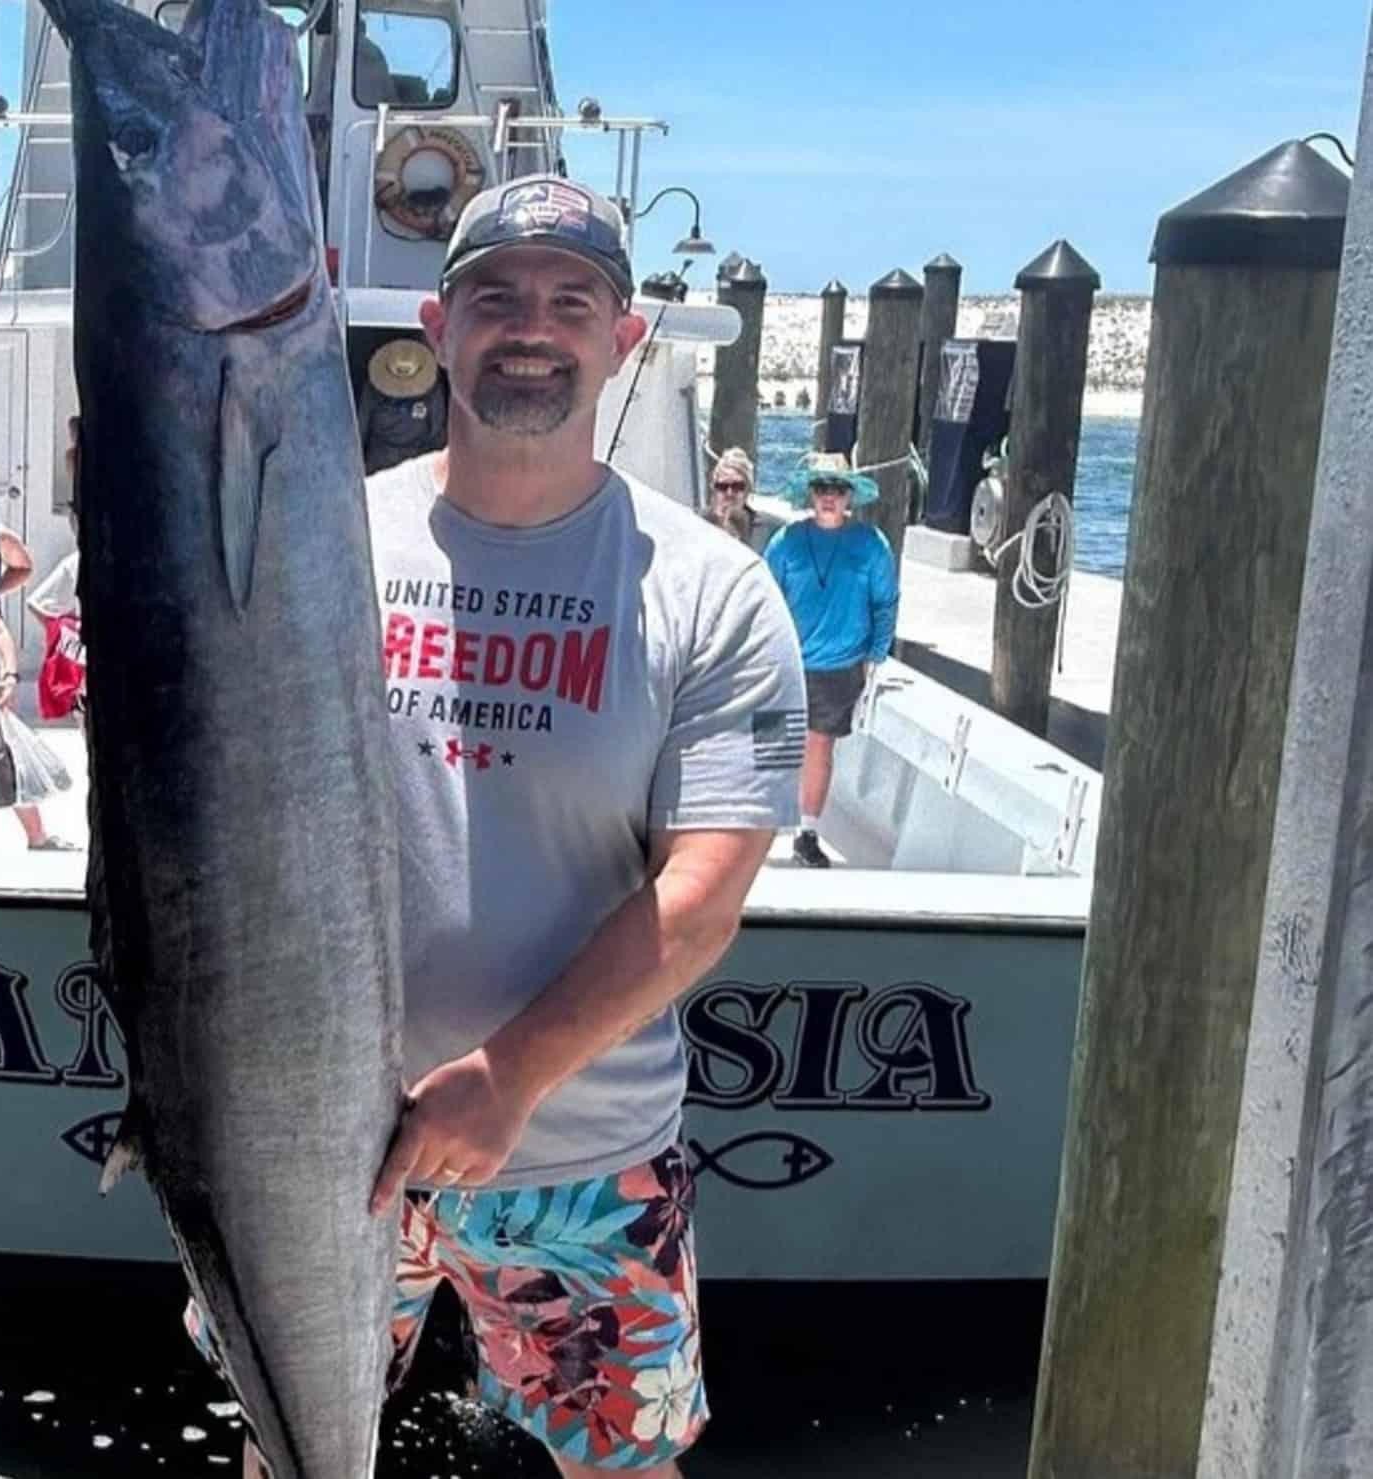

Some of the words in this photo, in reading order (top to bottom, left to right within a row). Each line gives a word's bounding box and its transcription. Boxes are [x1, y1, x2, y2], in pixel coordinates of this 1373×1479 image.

[384, 579, 485, 615] UNITED
[494, 588, 596, 625] STATES
[383, 611, 610, 714] REEDOM
[388, 687, 422, 718] OF
[428, 694, 554, 733] AMERICA
